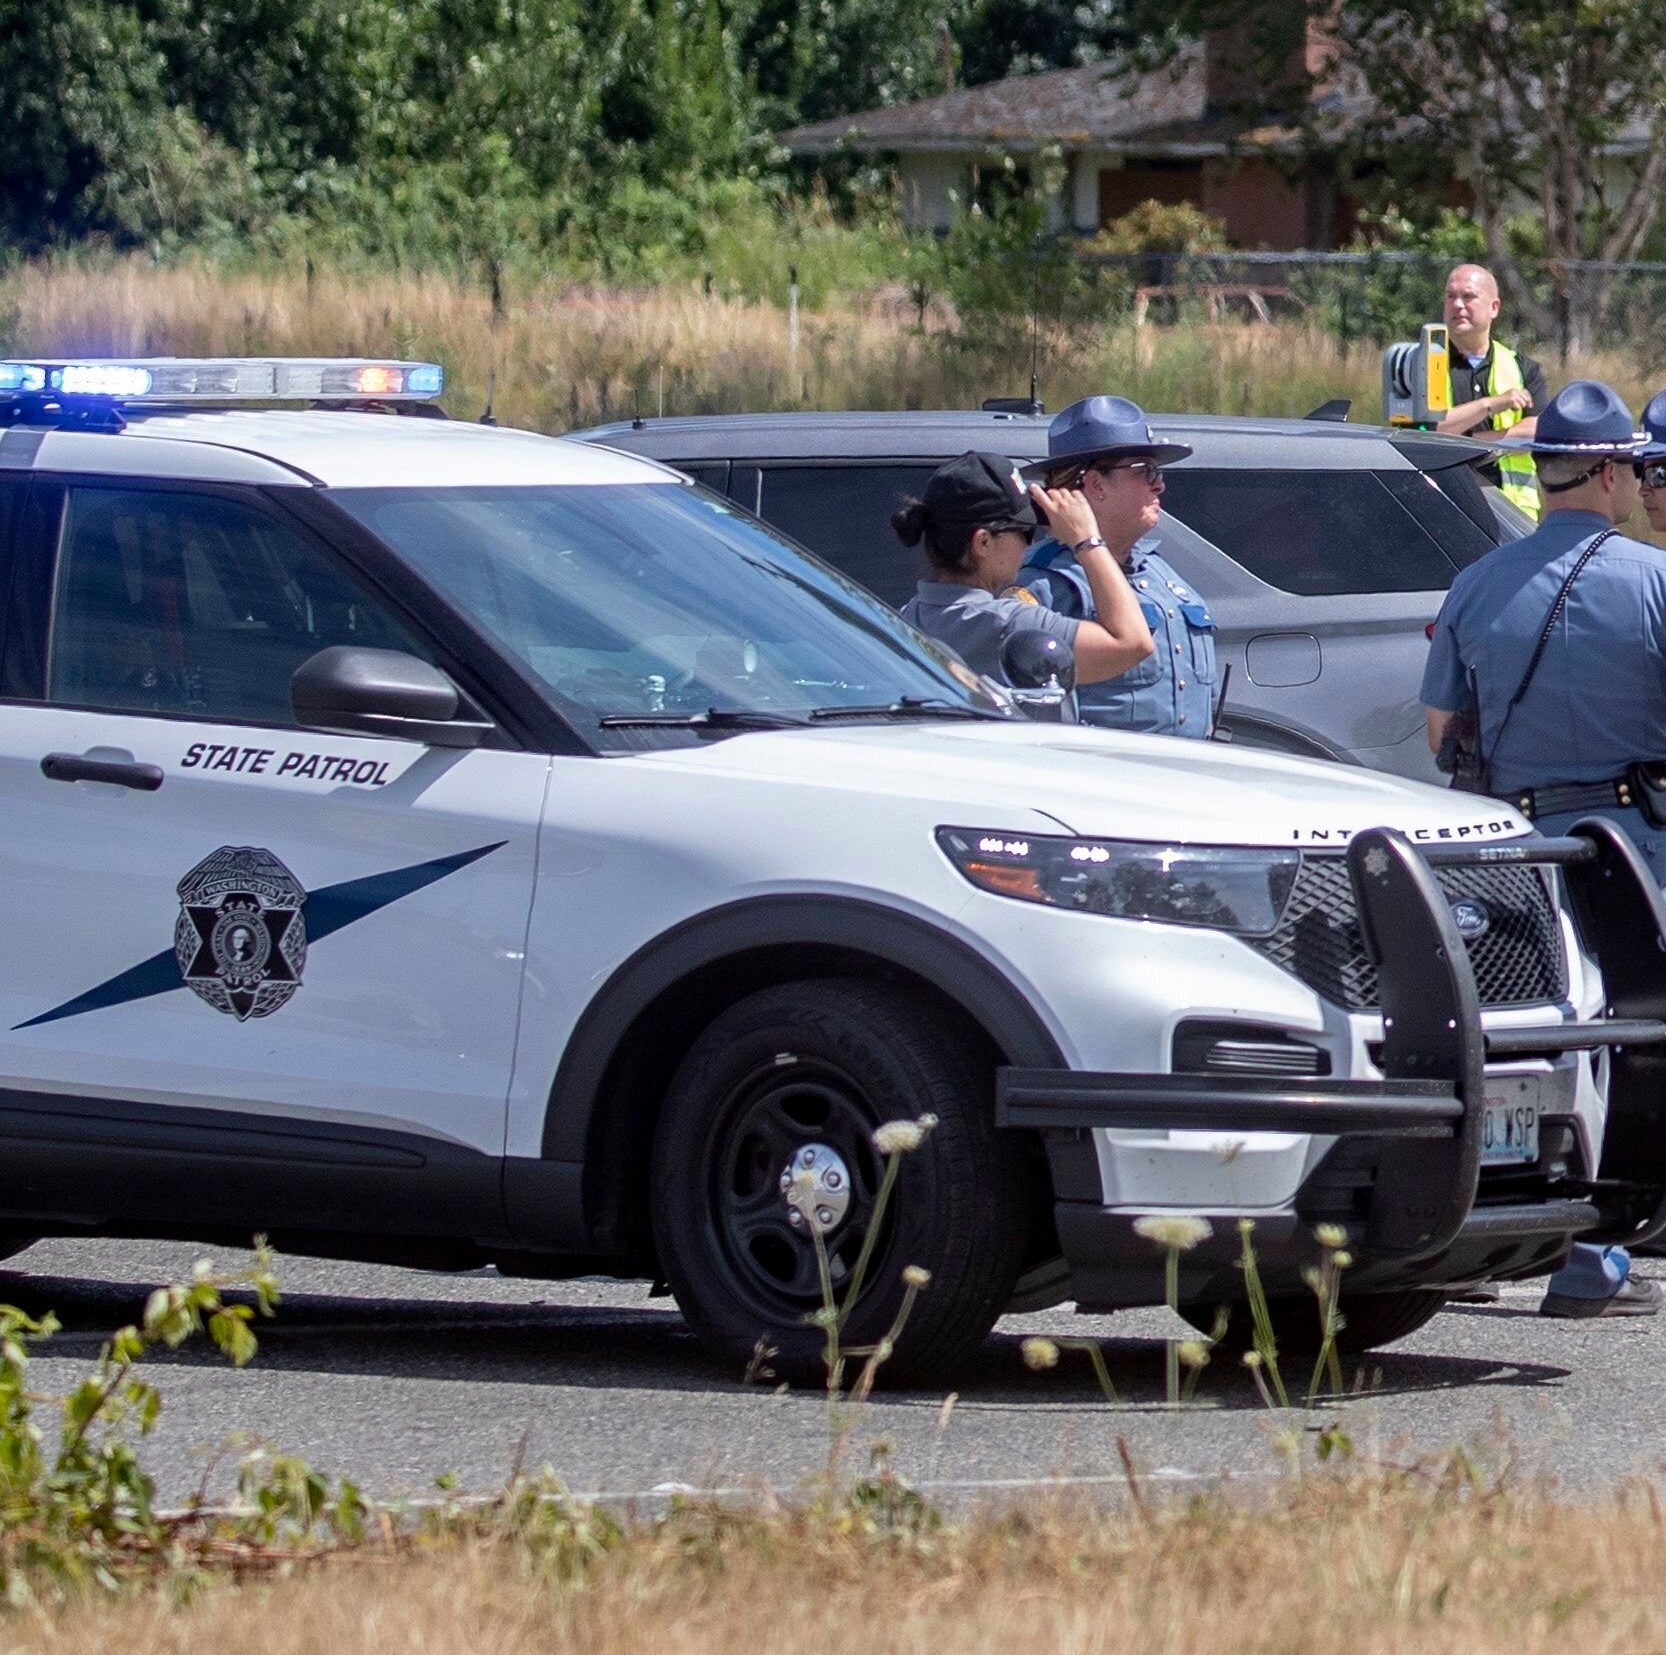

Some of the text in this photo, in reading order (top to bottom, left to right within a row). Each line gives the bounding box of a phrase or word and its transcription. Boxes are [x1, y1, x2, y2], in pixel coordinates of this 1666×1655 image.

[180, 742, 390, 786] STATE PATROL
[1292, 820, 1515, 841] INTCEPTOR
[204, 880, 277, 897] WASHINGTON
[214, 900, 268, 920] STATE
[214, 964, 271, 986] PATROL
